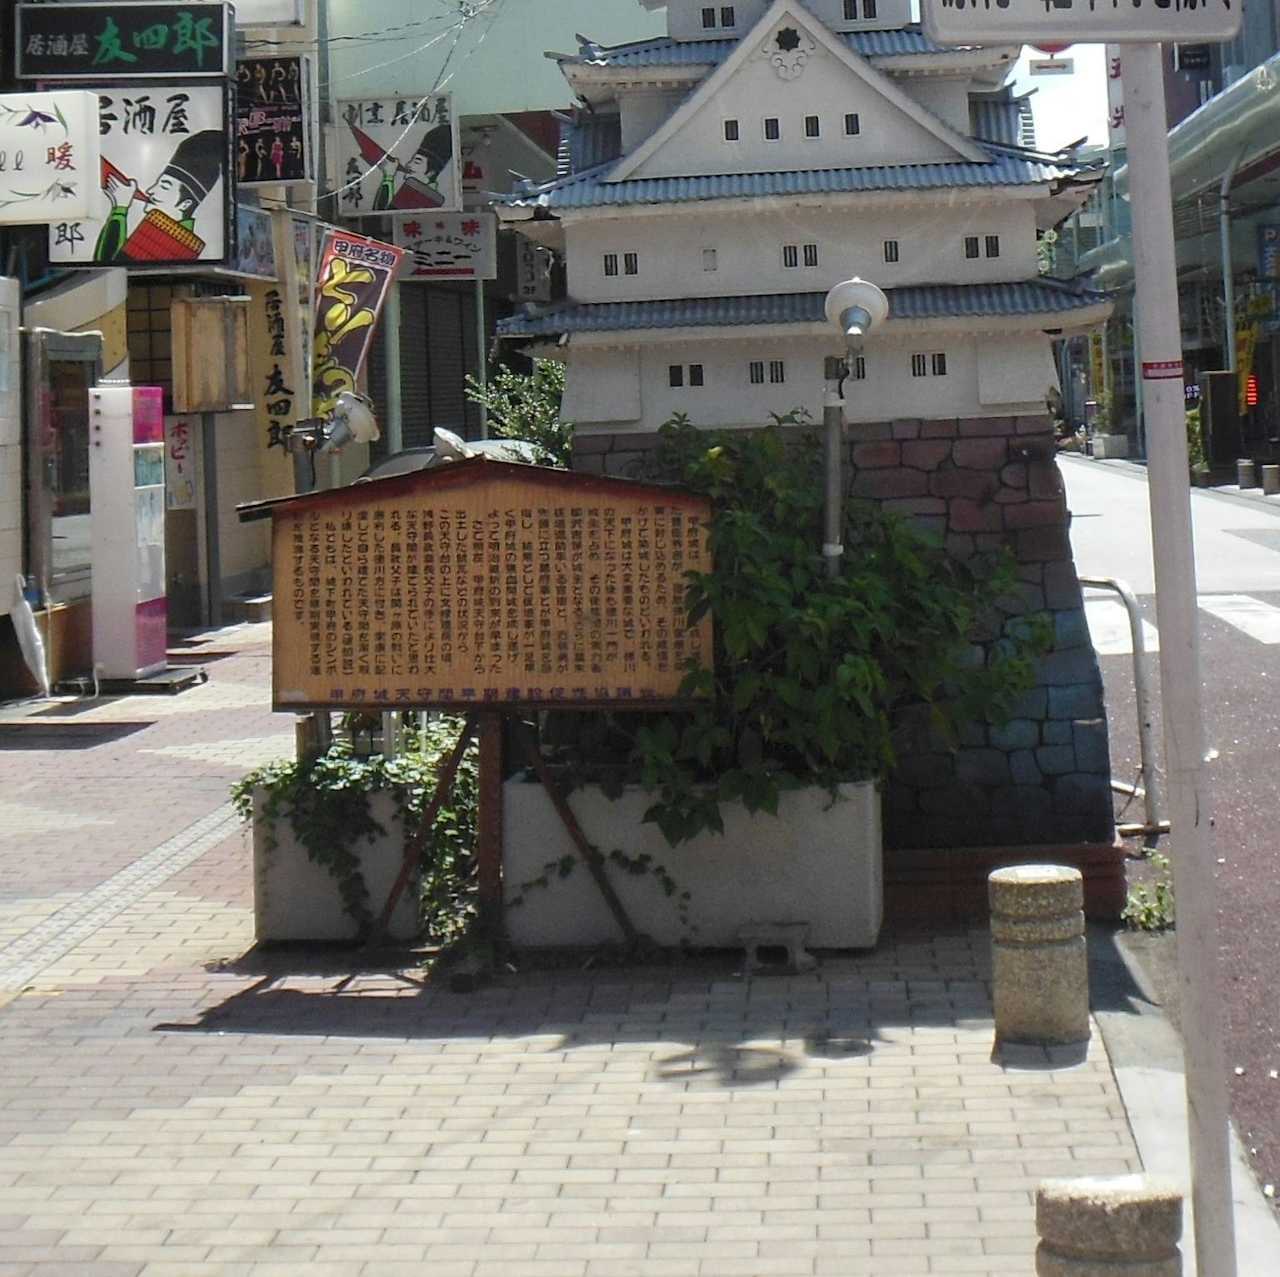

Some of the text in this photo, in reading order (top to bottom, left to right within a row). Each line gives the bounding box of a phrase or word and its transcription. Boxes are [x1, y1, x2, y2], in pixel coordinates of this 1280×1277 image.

[25, 34, 90, 56] 居酒屋
[46, 141, 77, 171] 暖
[333, 239, 397, 267] 甲府名物
[169, 422, 191, 474] ホッピー
